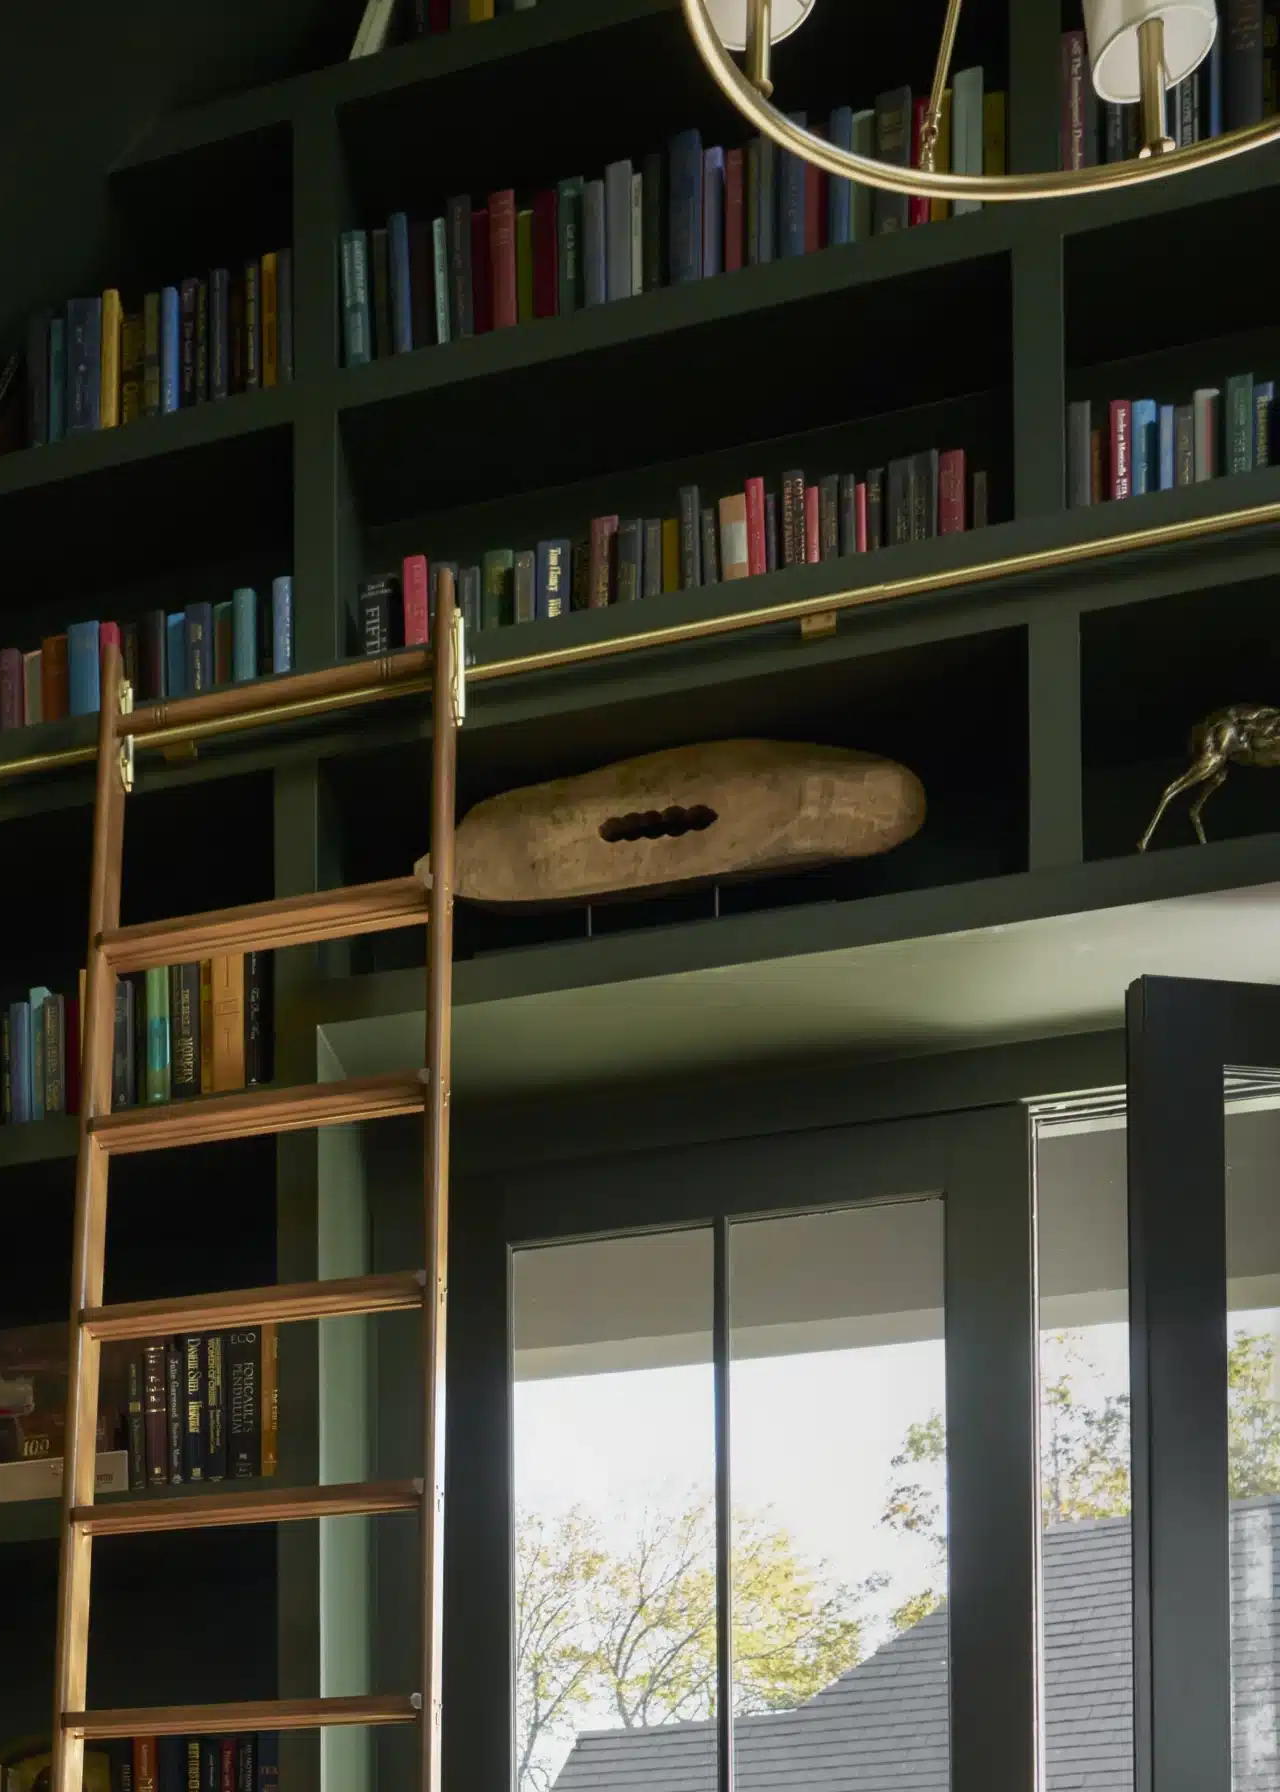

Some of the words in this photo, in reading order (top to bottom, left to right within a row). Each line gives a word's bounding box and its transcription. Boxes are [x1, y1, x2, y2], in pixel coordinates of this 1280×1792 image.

[182, 1036, 195, 1084] MODERN
[170, 1359, 180, 1380] Julie
[171, 1381, 180, 1418] Garwood
[231, 1363, 243, 1434] PENDULUM
